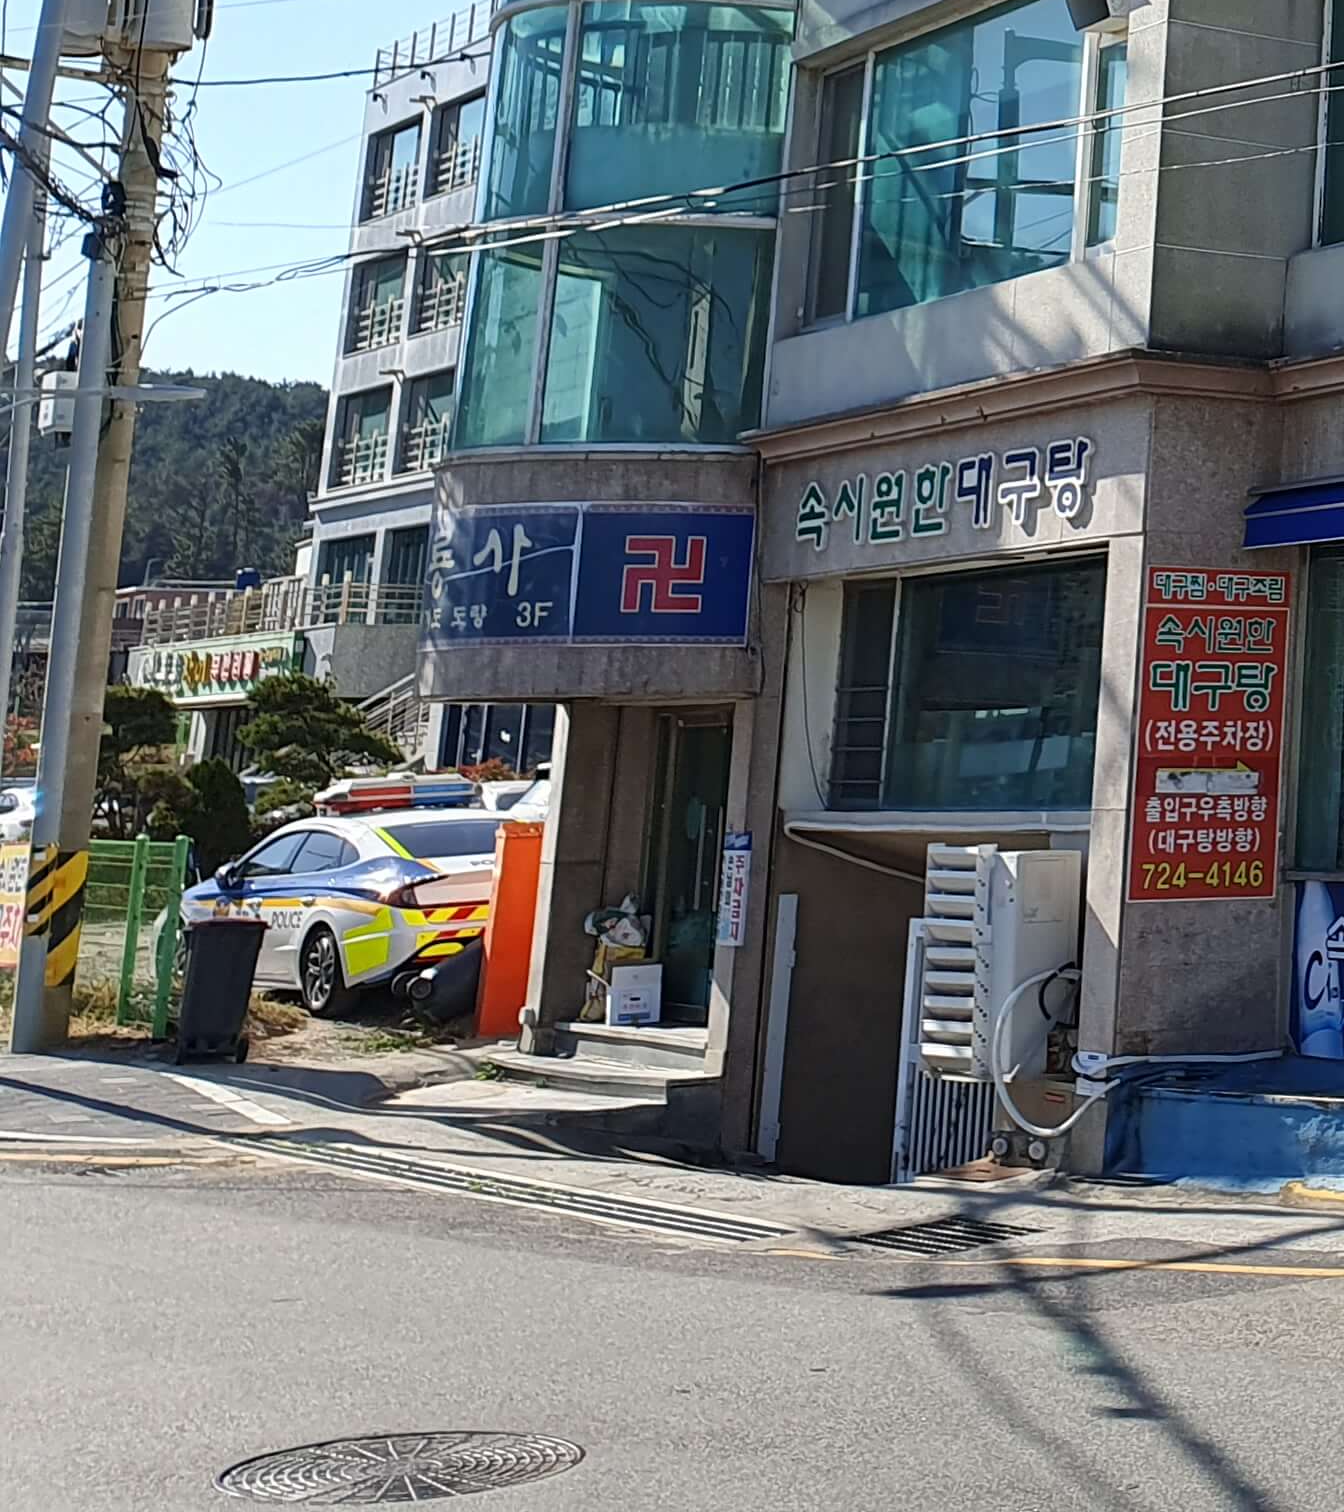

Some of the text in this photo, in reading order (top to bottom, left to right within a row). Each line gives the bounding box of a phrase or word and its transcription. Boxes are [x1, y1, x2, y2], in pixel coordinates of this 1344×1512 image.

[797, 435, 1094, 551] 속시원한 대구탕
[516, 601, 553, 627] 3F
[1155, 615, 1276, 654] 속시원한
[1150, 660, 1278, 712] 대구탕
[1145, 720, 1273, 752] (전용주차장)
[1144, 796, 1268, 823] 출입구우측방향
[1148, 827, 1261, 855] (대구탕방향)
[1141, 860, 1264, 890] 724-4146
[271, 910, 302, 929] POLICE
